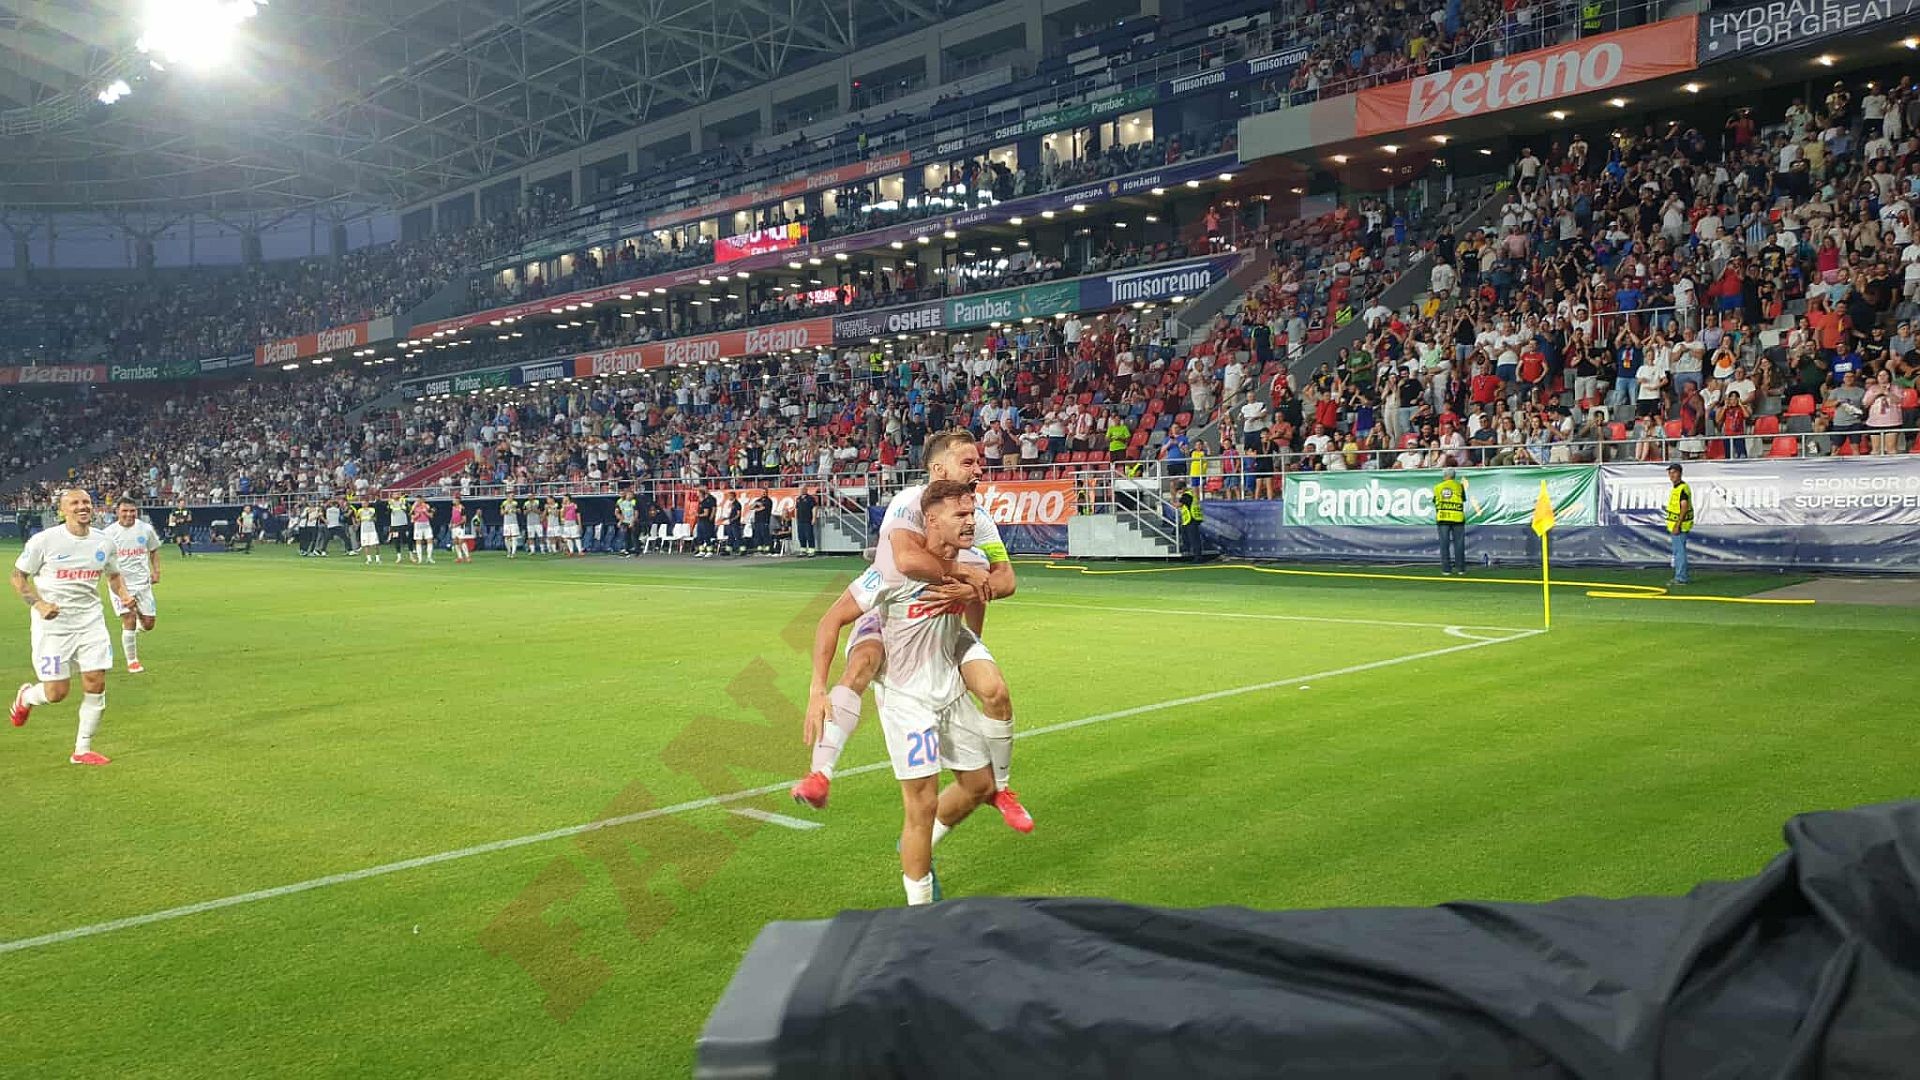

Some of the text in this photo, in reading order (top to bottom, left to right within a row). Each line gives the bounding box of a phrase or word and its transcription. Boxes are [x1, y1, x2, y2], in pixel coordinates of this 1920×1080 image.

[1737, 0, 1893, 50] FOR GREAT
[1406, 42, 1623, 125] Betano
[1091, 97, 1125, 114] Pambac
[995, 123, 1024, 140] OSHEE
[937, 139, 964, 154] OSHEE
[1064, 188, 1104, 203] SUPERCUPA
[888, 308, 941, 332] OSHEE
[954, 298, 1012, 323] Pambac
[317, 328, 357, 353] Betano
[745, 328, 808, 354] Betano
[842, 325, 882, 338] FOR GREAT
[263, 342, 298, 364] Betano
[592, 351, 643, 375] Betano
[663, 339, 721, 366] Betano
[18, 365, 96, 384] Betano
[111, 364, 158, 381] Pambac
[455, 376, 481, 391] Pambac
[426, 381, 450, 395] OSHEE
[1801, 477, 1899, 491] SPONSOR
[975, 486, 1064, 525] tano
[1298, 480, 1433, 518] Pambac
[41, 655, 61, 675] 21
[907, 729, 940, 767] 20
